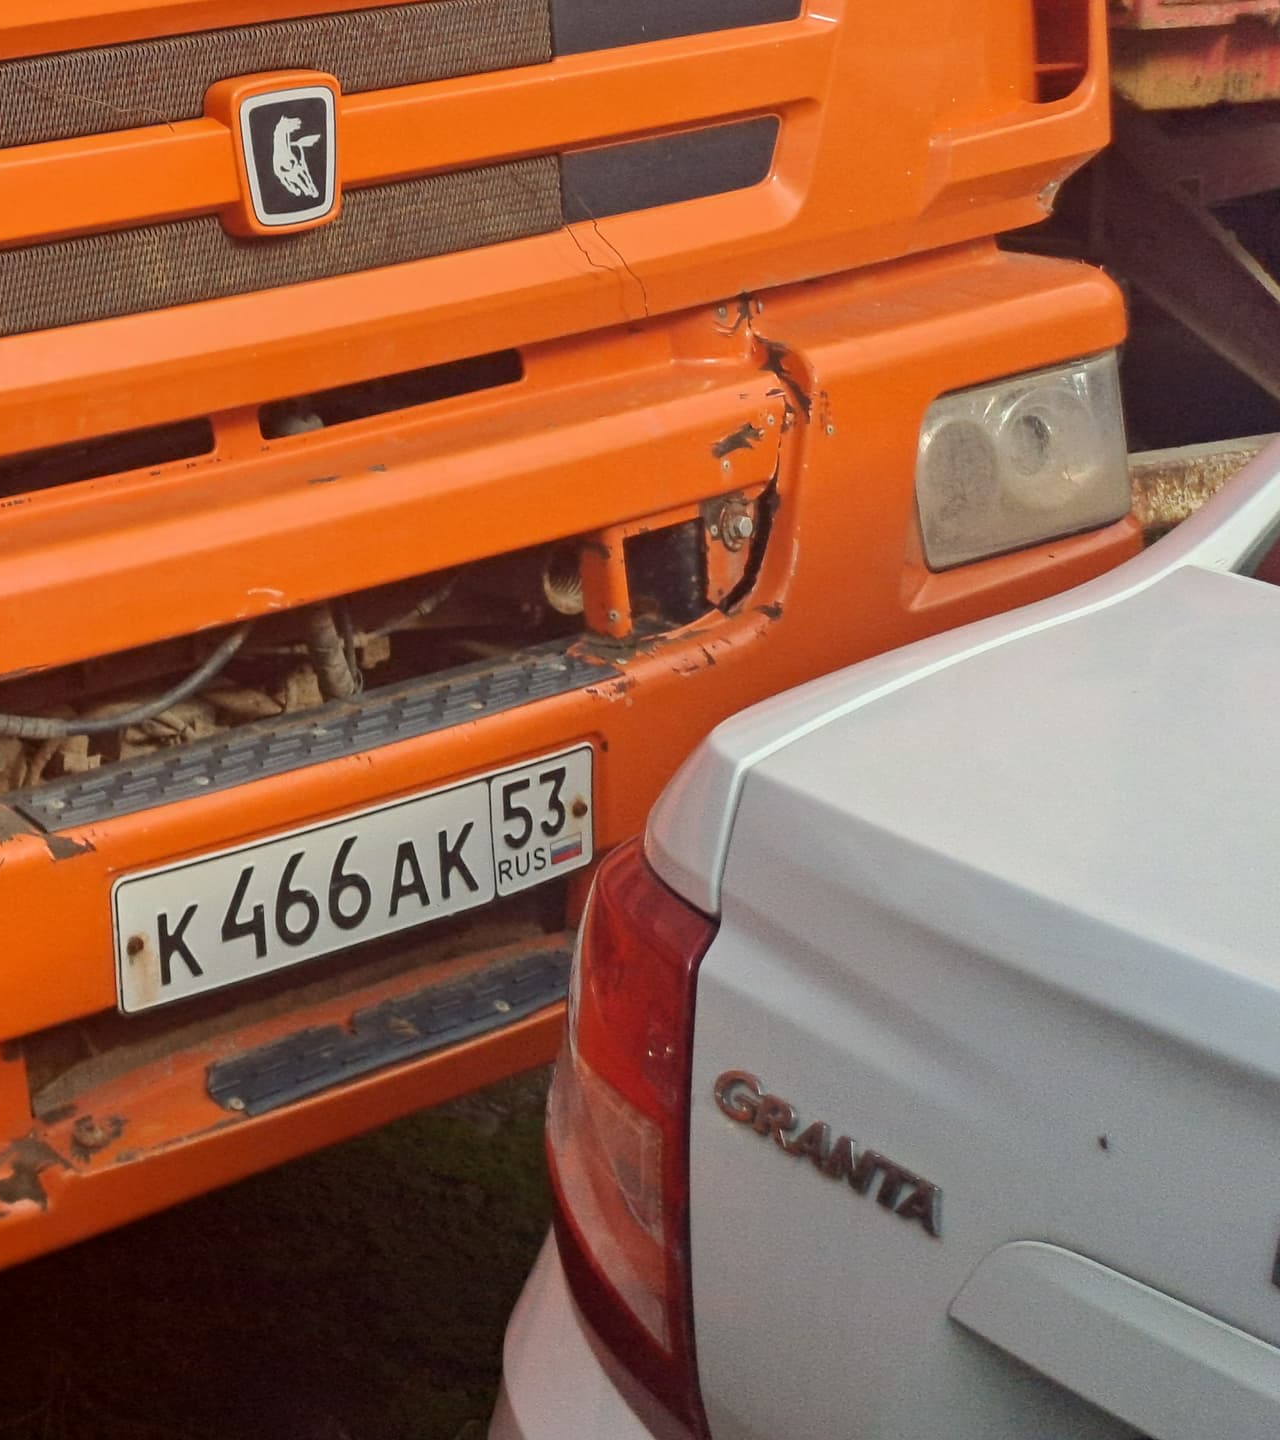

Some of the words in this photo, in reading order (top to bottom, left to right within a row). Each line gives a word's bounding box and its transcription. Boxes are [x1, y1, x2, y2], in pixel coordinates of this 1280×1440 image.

[502, 766, 568, 850] 53
[498, 846, 547, 885] RUS
[713, 1069, 944, 1239] GRANTA
